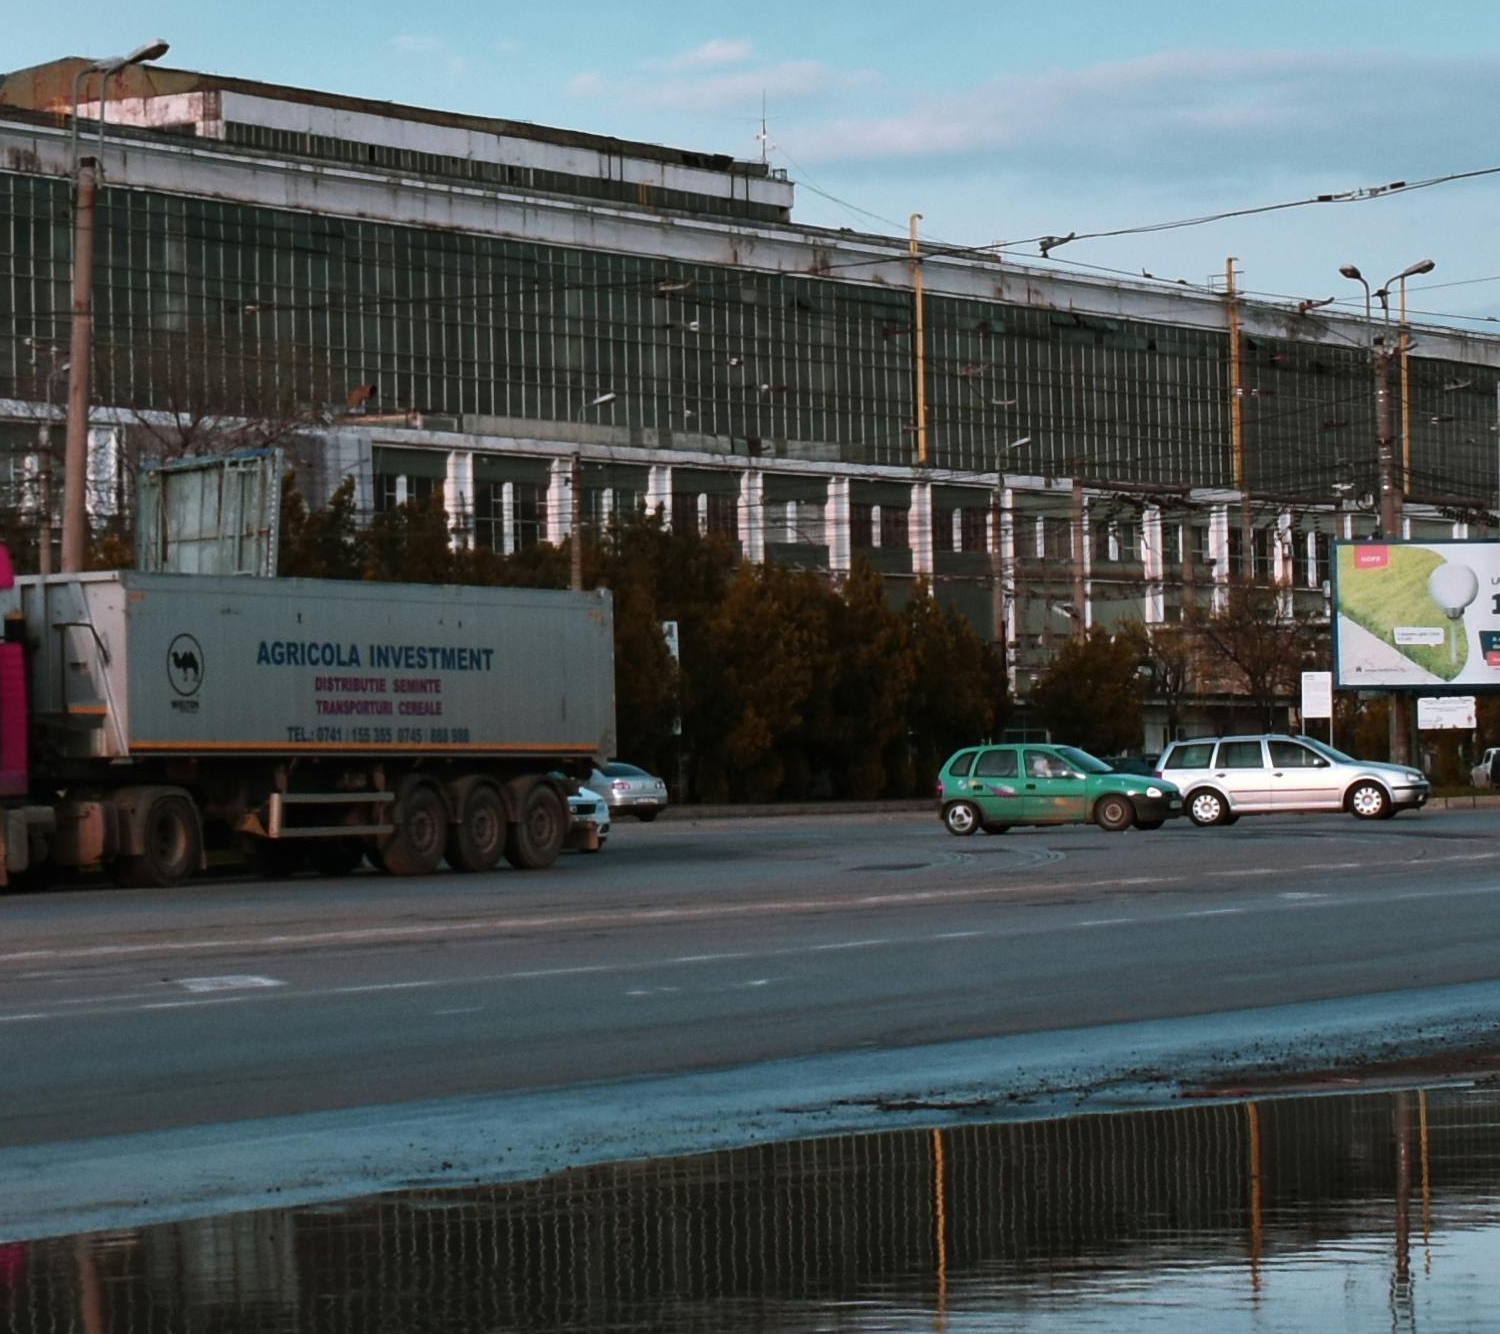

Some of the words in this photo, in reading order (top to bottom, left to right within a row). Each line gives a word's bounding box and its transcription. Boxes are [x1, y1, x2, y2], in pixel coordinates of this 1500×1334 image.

[257, 641, 361, 667] AGRICOLA
[370, 644, 494, 671] INVESTMENT
[315, 676, 386, 693] DISTRIBUTIE
[393, 678, 441, 693] SEMINTE
[315, 700, 393, 716] TRANSPORTURI
[398, 701, 442, 716] CEREALE
